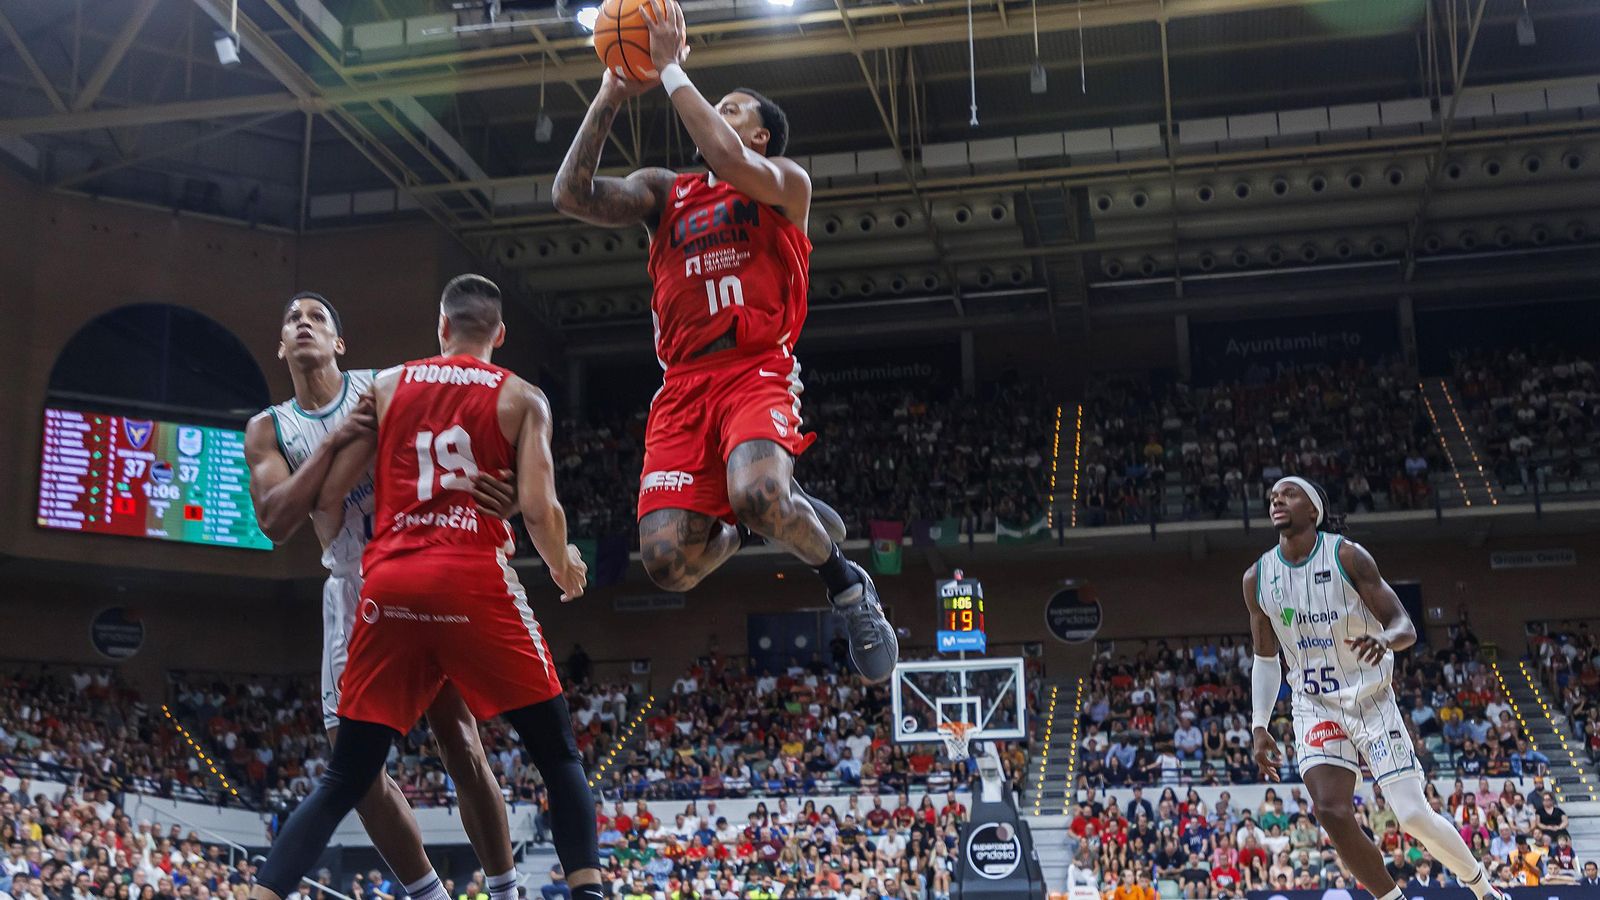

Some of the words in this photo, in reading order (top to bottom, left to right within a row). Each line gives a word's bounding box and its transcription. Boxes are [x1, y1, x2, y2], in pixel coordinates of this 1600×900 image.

[670, 198, 760, 249] UCAM
[683, 227, 751, 256] MURCIA
[705, 274, 745, 316] 10
[1224, 331, 1362, 359] Ayuntamieto
[807, 362, 932, 385] Ayuntamiento
[124, 458, 147, 479] 37
[178, 463, 200, 483] 37
[416, 424, 480, 502] 19
[141, 481, 181, 500] 1:06
[950, 609, 973, 632] 19
[1303, 666, 1341, 695] 55
